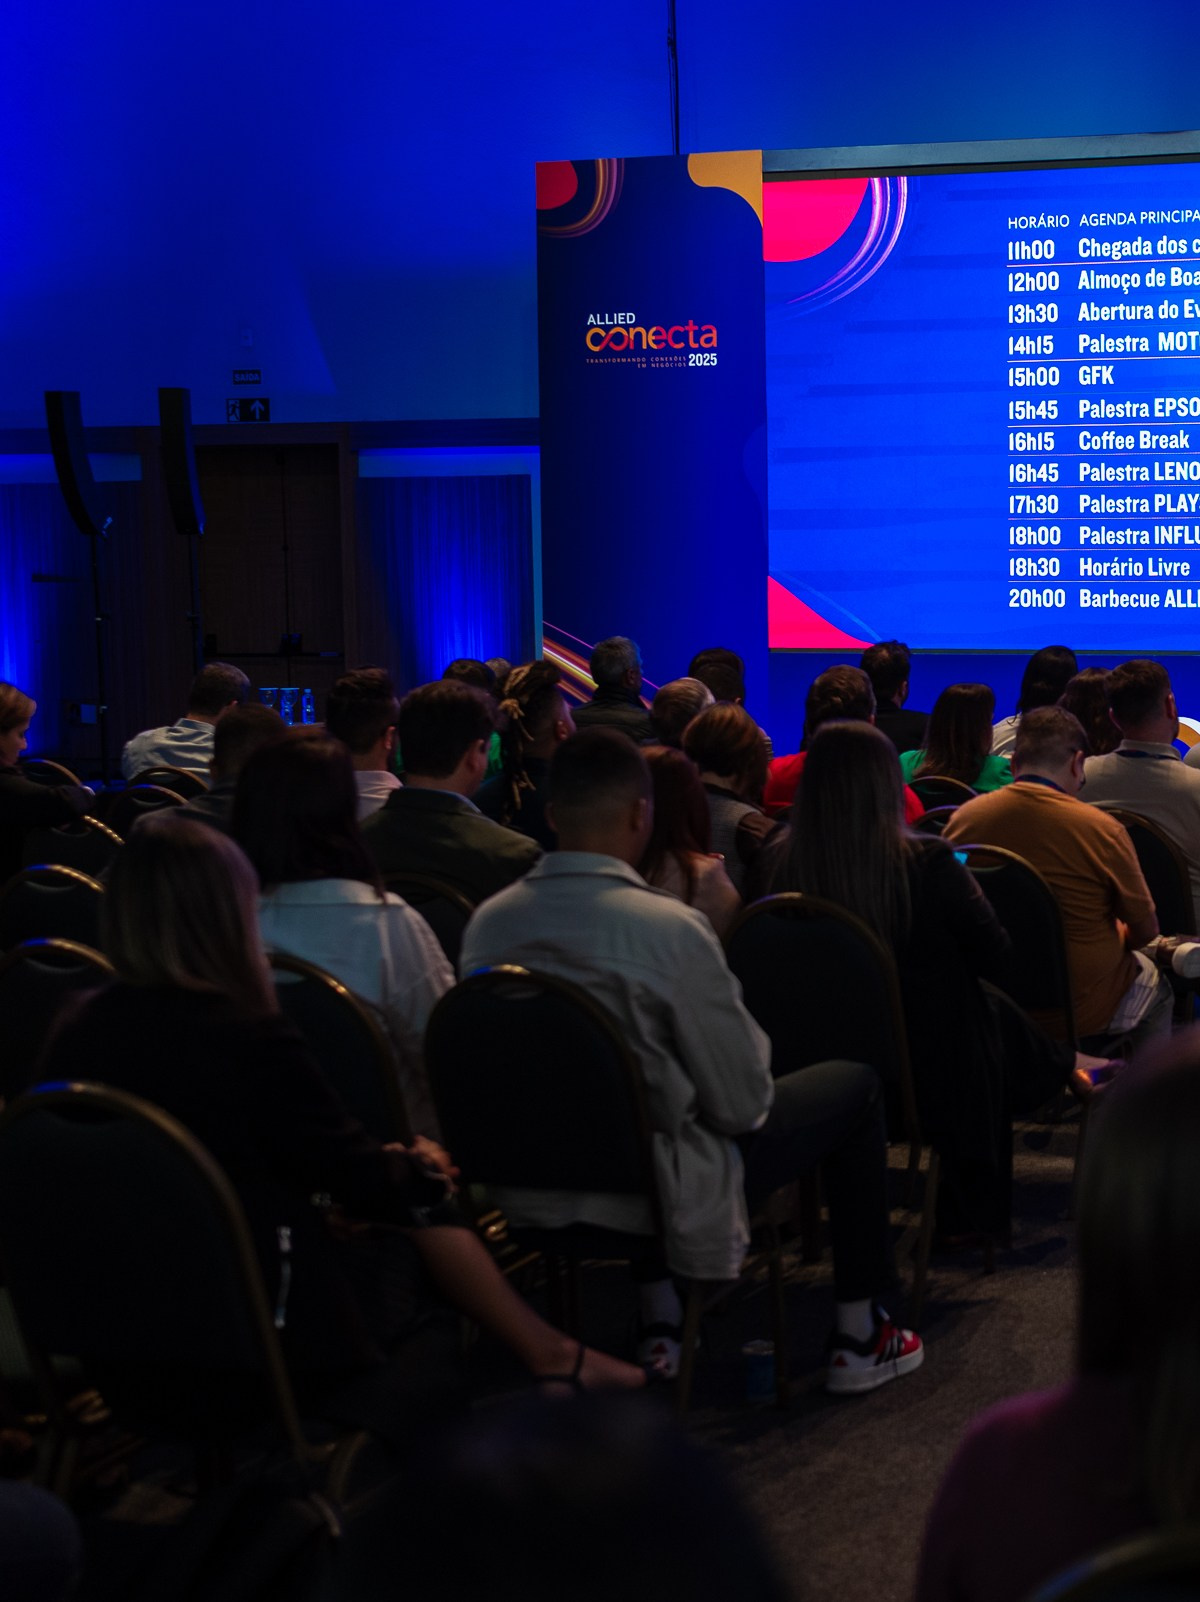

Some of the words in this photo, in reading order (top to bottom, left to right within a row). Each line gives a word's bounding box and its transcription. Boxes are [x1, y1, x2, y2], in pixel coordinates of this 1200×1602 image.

[1009, 213, 1069, 229] HORÁRIO
[1080, 212, 1136, 226] AGENDA
[1009, 240, 1054, 260] 11h00
[1079, 237, 1152, 260] Chegada
[1157, 236, 1187, 254] dos
[1009, 271, 1059, 292] 12h00
[1078, 270, 1140, 294] Almoço
[1146, 268, 1165, 287] de
[587, 312, 636, 325] ALLIED
[1009, 303, 1058, 323] 13h30
[1078, 302, 1153, 321] Abertura
[1159, 300, 1178, 319] do
[1009, 335, 1053, 354] 14h15
[1079, 334, 1149, 353] Palestra
[688, 353, 717, 367] 2025
[1009, 367, 1059, 386] 15h00
[1079, 366, 1114, 385] GFK
[1009, 400, 1058, 419] 15h45
[1079, 400, 1149, 418] Palestra
[1010, 432, 1054, 451] 16h15
[1079, 431, 1134, 450] Coffee
[1140, 430, 1189, 449] Break
[1010, 463, 1058, 482] 16h45
[1080, 463, 1149, 481] Palestra
[1010, 495, 1058, 513] 17h30
[1080, 495, 1149, 513] Palestra
[1010, 526, 1060, 545] 18h00
[1080, 526, 1149, 544] Palestra
[1010, 558, 1059, 576] 18h30
[1080, 557, 1143, 576] Horário
[1149, 558, 1190, 576] Livre
[1009, 589, 1065, 607] 20h00
[1080, 589, 1159, 607] Barbecue
